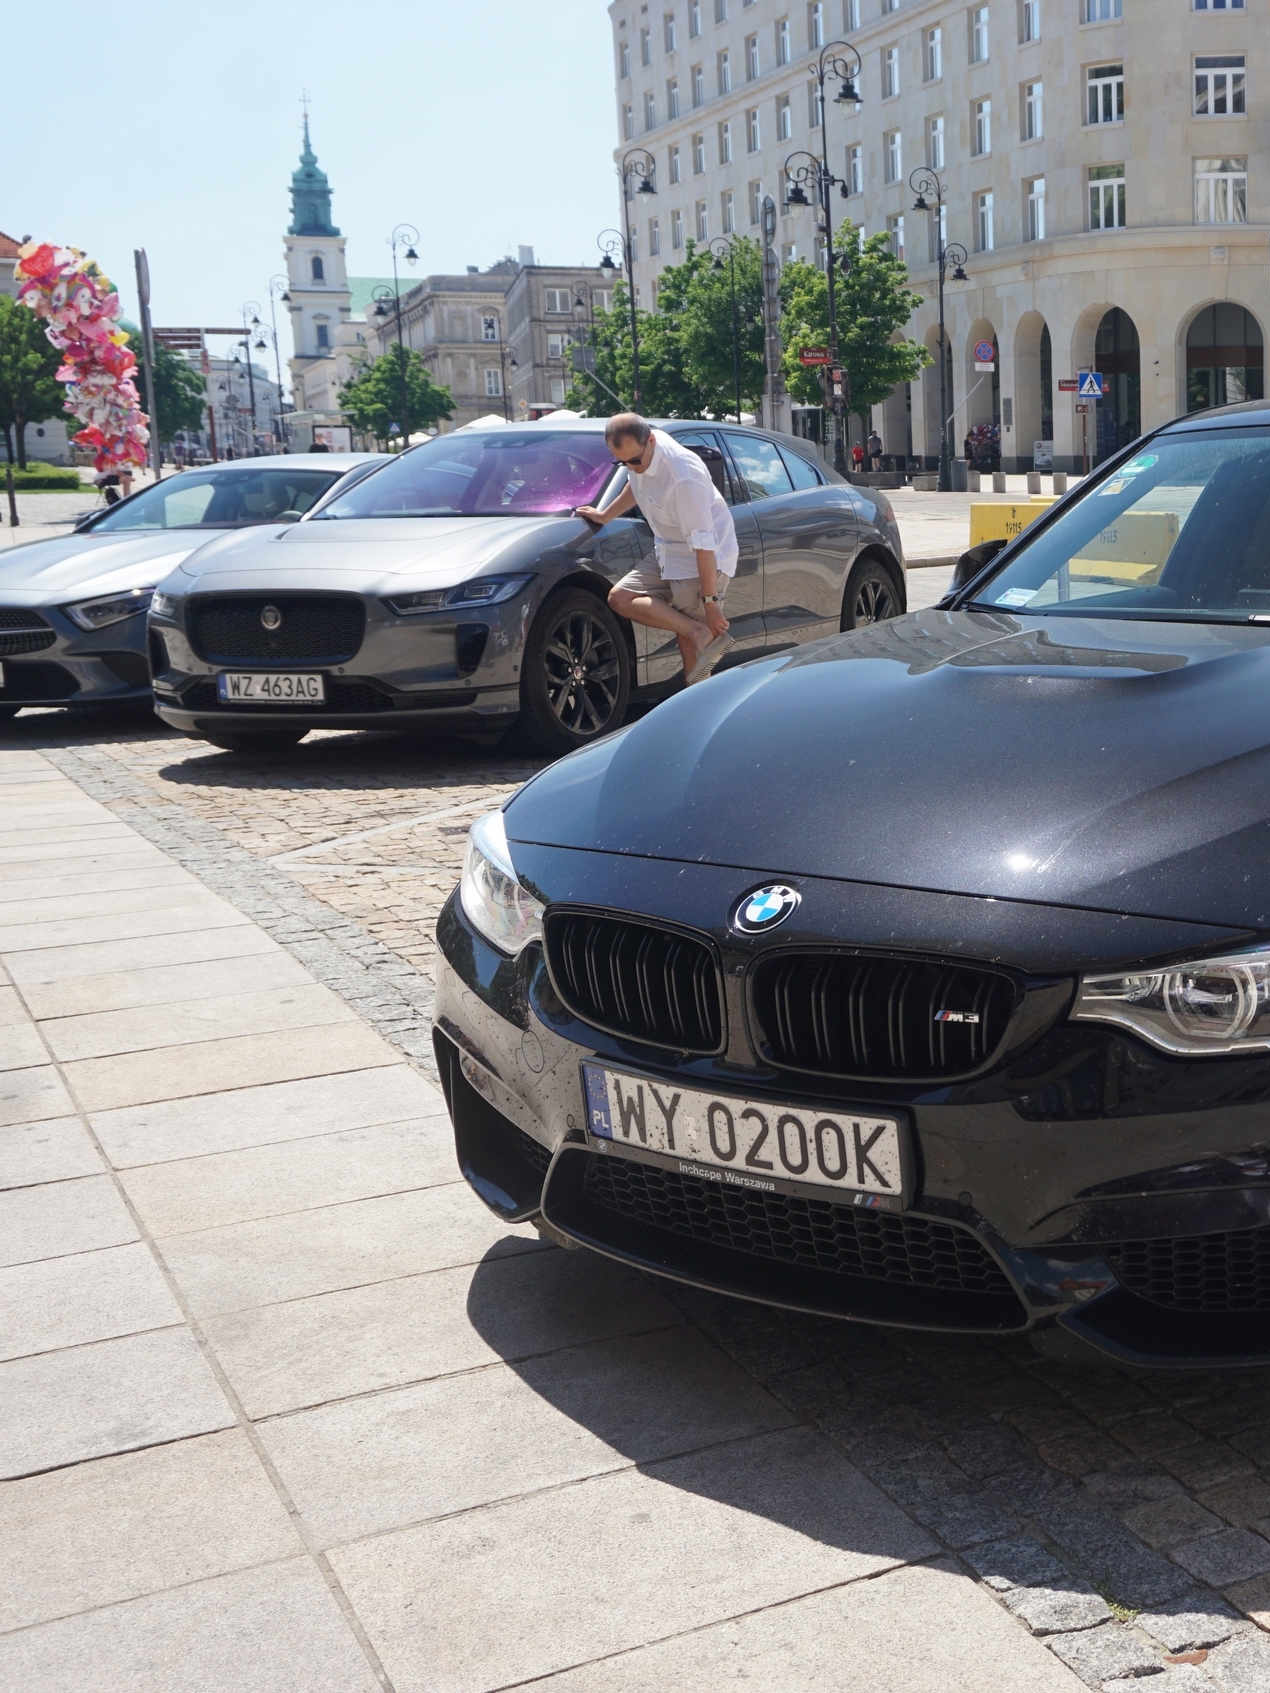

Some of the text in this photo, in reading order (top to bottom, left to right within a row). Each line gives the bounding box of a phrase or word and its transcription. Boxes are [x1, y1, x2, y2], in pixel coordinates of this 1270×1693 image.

[1005, 521, 1022, 534] 19115
[229, 676, 318, 698] WZ 463AG
[942, 1011, 980, 1023] M3
[591, 1109, 610, 1129] PL
[613, 1078, 893, 1189] WY 0200K
[679, 1161, 776, 1191] Inchcape Warszawa
